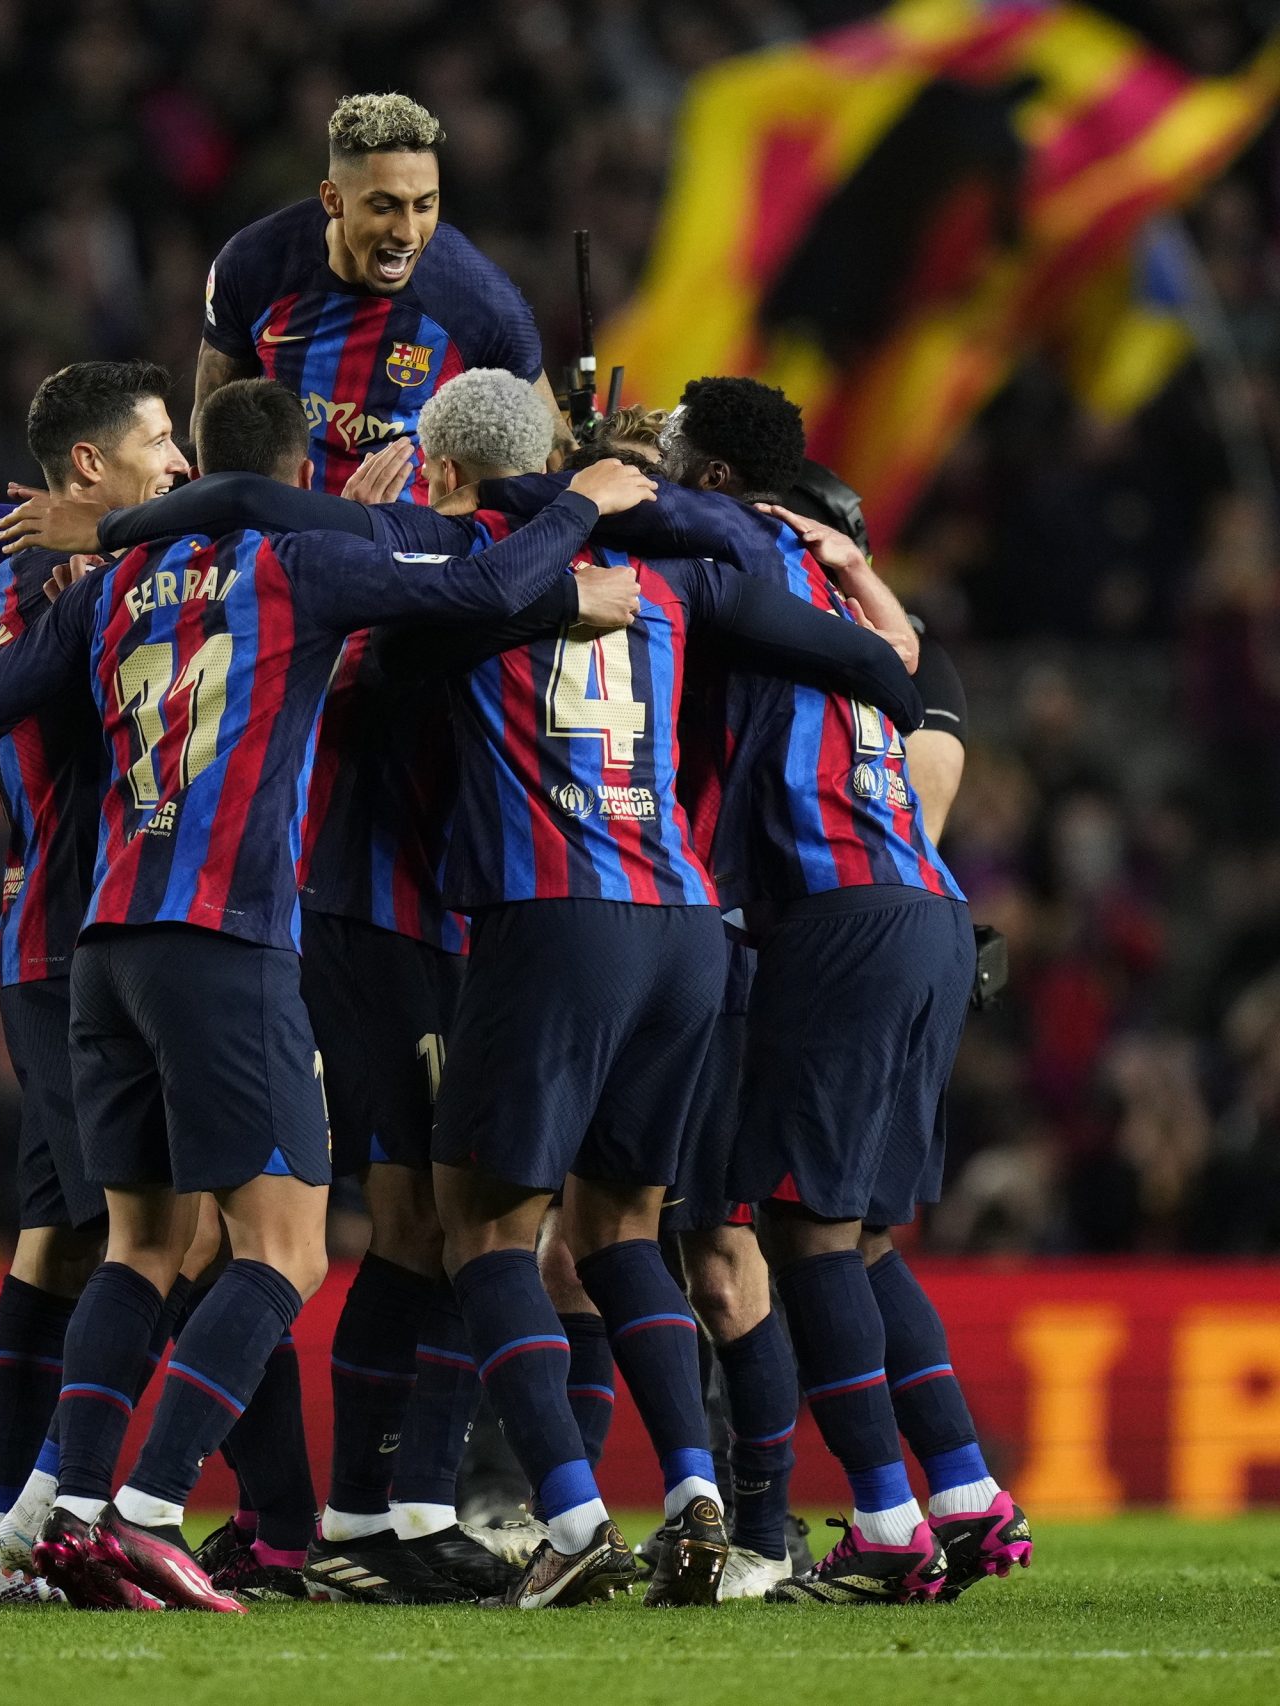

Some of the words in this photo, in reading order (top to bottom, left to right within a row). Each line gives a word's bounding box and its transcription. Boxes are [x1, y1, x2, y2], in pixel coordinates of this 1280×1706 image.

[399, 358, 418, 368] FCB
[546, 618, 646, 770] 4
[597, 785, 654, 802] UNHCR
[598, 800, 656, 816] ACNUR
